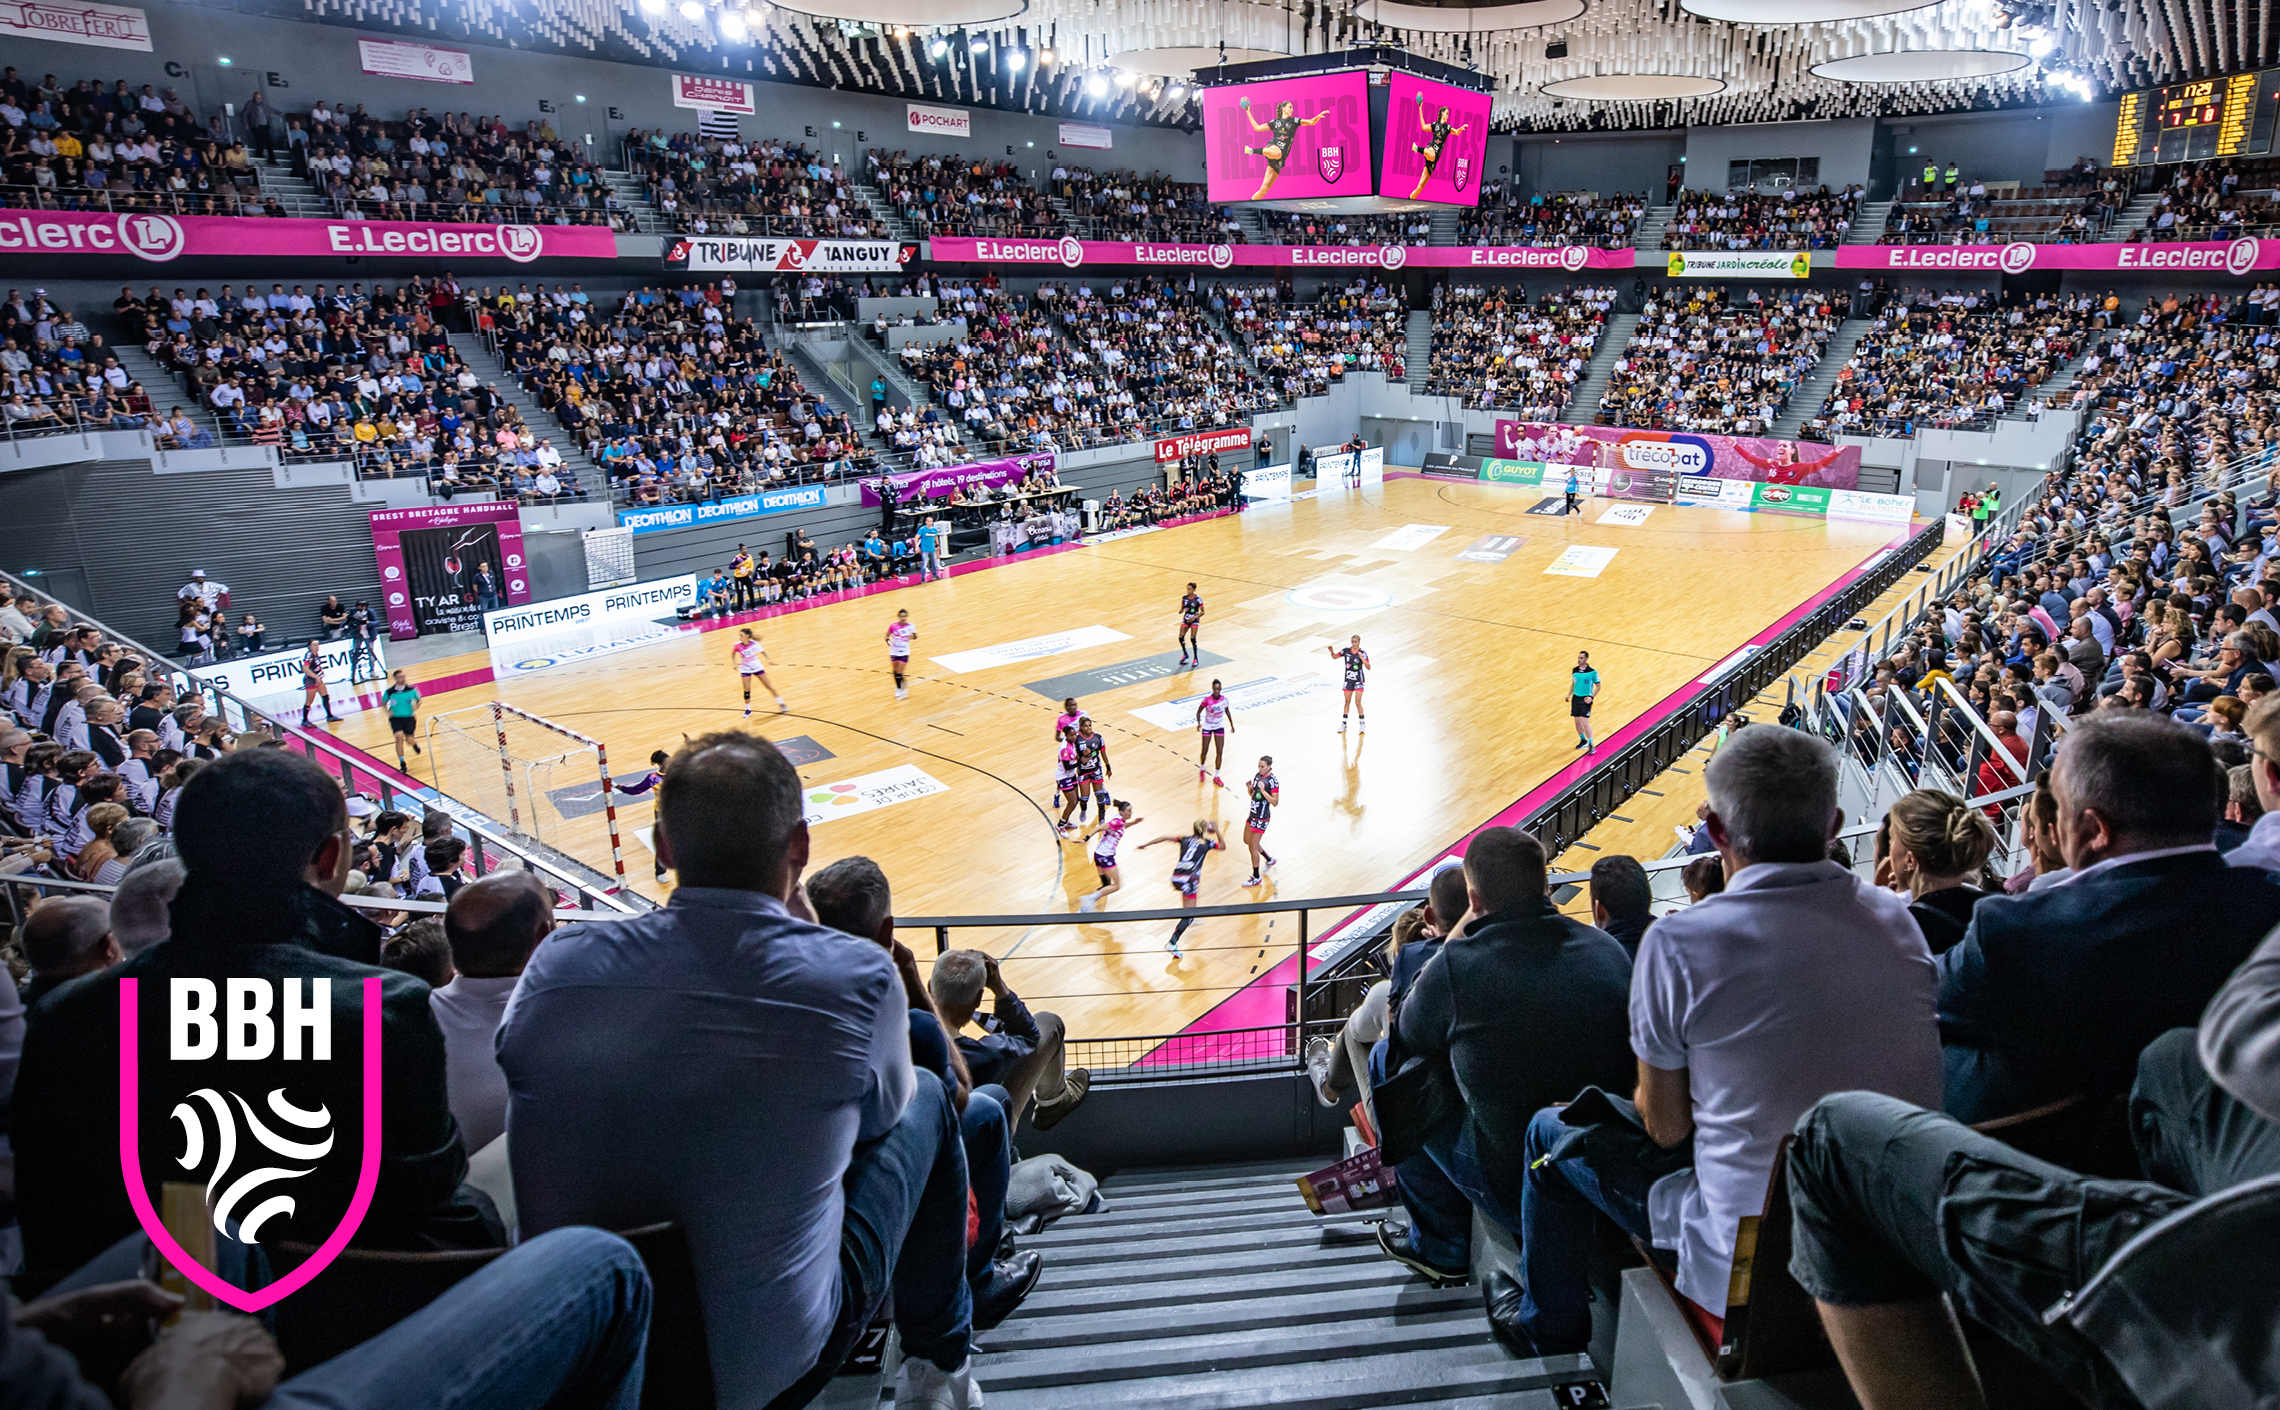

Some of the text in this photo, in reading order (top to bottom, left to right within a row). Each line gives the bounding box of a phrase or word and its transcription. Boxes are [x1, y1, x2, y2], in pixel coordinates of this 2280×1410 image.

[694, 86, 733, 96] DENIS
[922, 114, 968, 129] POCHART
[2172, 113, 2181, 126] 7
[2204, 108, 2215, 122] 8
[1322, 147, 1339, 158] BBH
[1458, 158, 1468, 168] BBH
[327, 225, 495, 252] E.Leclerc
[698, 241, 891, 264] TRIBUNE TANGUY
[976, 242, 1058, 261] E.Leclerc
[1135, 246, 1207, 263] E.Leclerc
[1291, 248, 1378, 265] E.Leclerc
[1471, 249, 1559, 266] E.Leclerc
[1889, 249, 1998, 267] E.Leclerc
[2117, 247, 2226, 267] E.Leclerc
[1686, 259, 1788, 270] TRIBUNE JARDIN créole
[1291, 424, 1297, 434] 2
[1158, 433, 1249, 459] Le Télégramme
[1255, 469, 1289, 482] PRINTEMPS
[1503, 464, 1539, 476] GUYOT
[1767, 468, 1777, 478] 16
[920, 480, 931, 490] 28
[957, 475, 965, 483] 19
[966, 469, 1007, 482] destinations
[372, 504, 513, 521] BREST BRETAGNE HANDBALL
[624, 490, 820, 528] DECATHLON DECATHLON DECATHLON
[414, 596, 436, 608] TY
[438, 594, 460, 606] AR
[605, 584, 692, 612] PRINTEMPS
[450, 621, 479, 632] Brest
[493, 603, 591, 635] PRINTEMPS
[558, 632, 664, 659] LIZIARD
[1568, 1386, 1587, 1405] P
